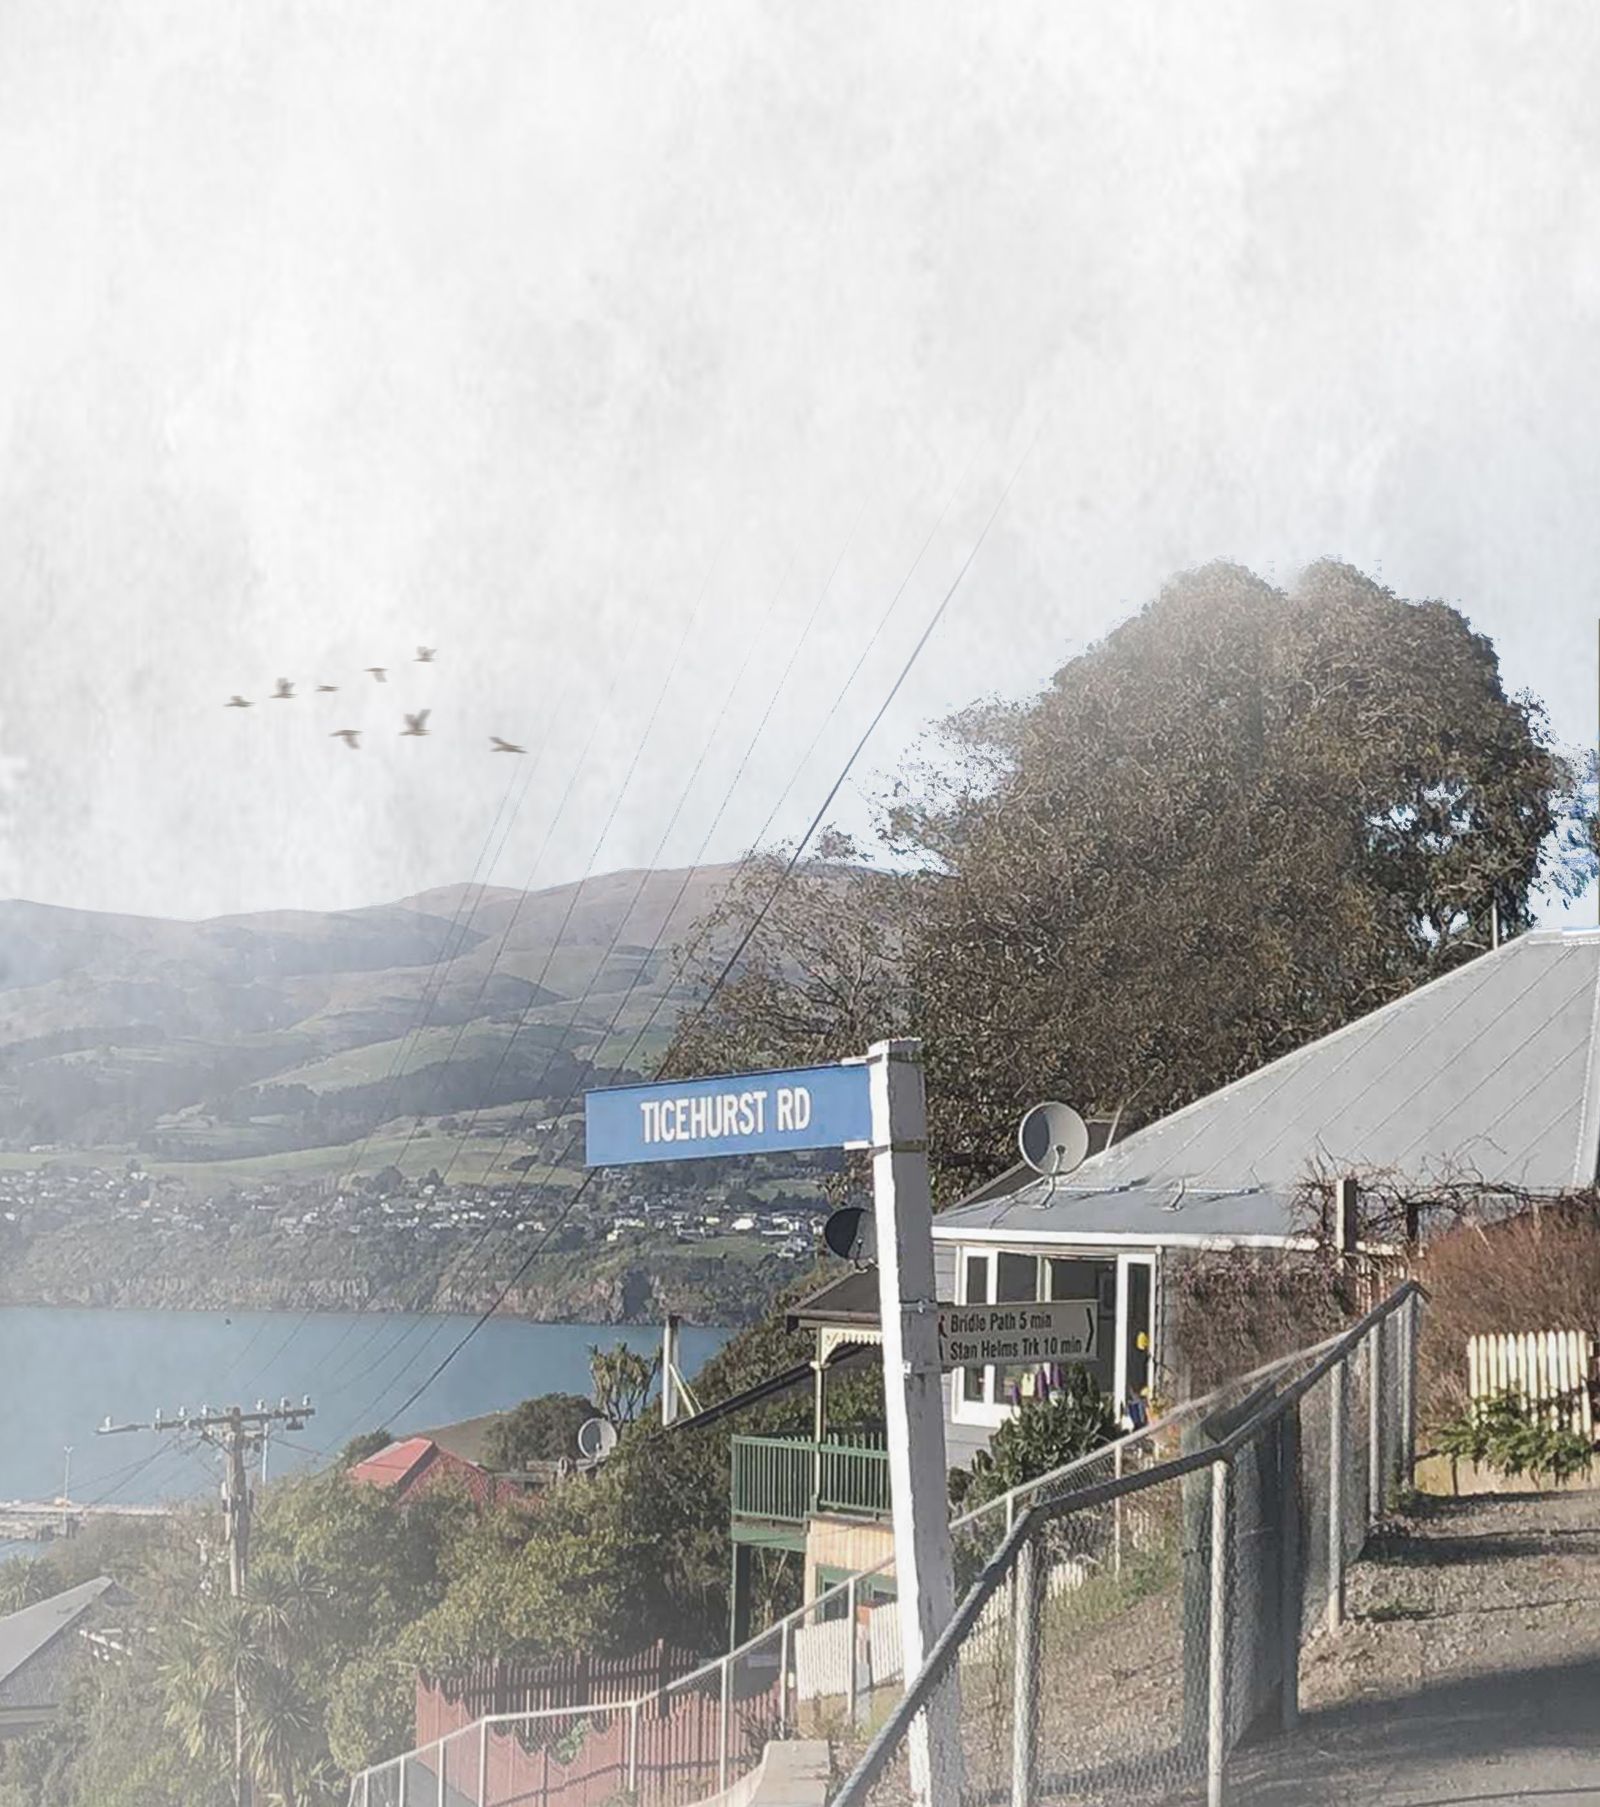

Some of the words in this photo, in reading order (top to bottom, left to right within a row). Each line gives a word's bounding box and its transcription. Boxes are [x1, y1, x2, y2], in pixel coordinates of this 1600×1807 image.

[640, 1090, 767, 1144] TICEHURST
[777, 1087, 811, 1131] RD
[951, 1314, 986, 1334] Bridle
[990, 1312, 1017, 1332] Path
[1019, 1312, 1027, 1329] 5
[1030, 1312, 1052, 1329] min
[950, 1341, 978, 1361] Stan
[981, 1339, 1018, 1359] Helms
[1022, 1337, 1040, 1357] Trk
[1044, 1337, 1058, 1355] 10
[1060, 1336, 1082, 1354] min
